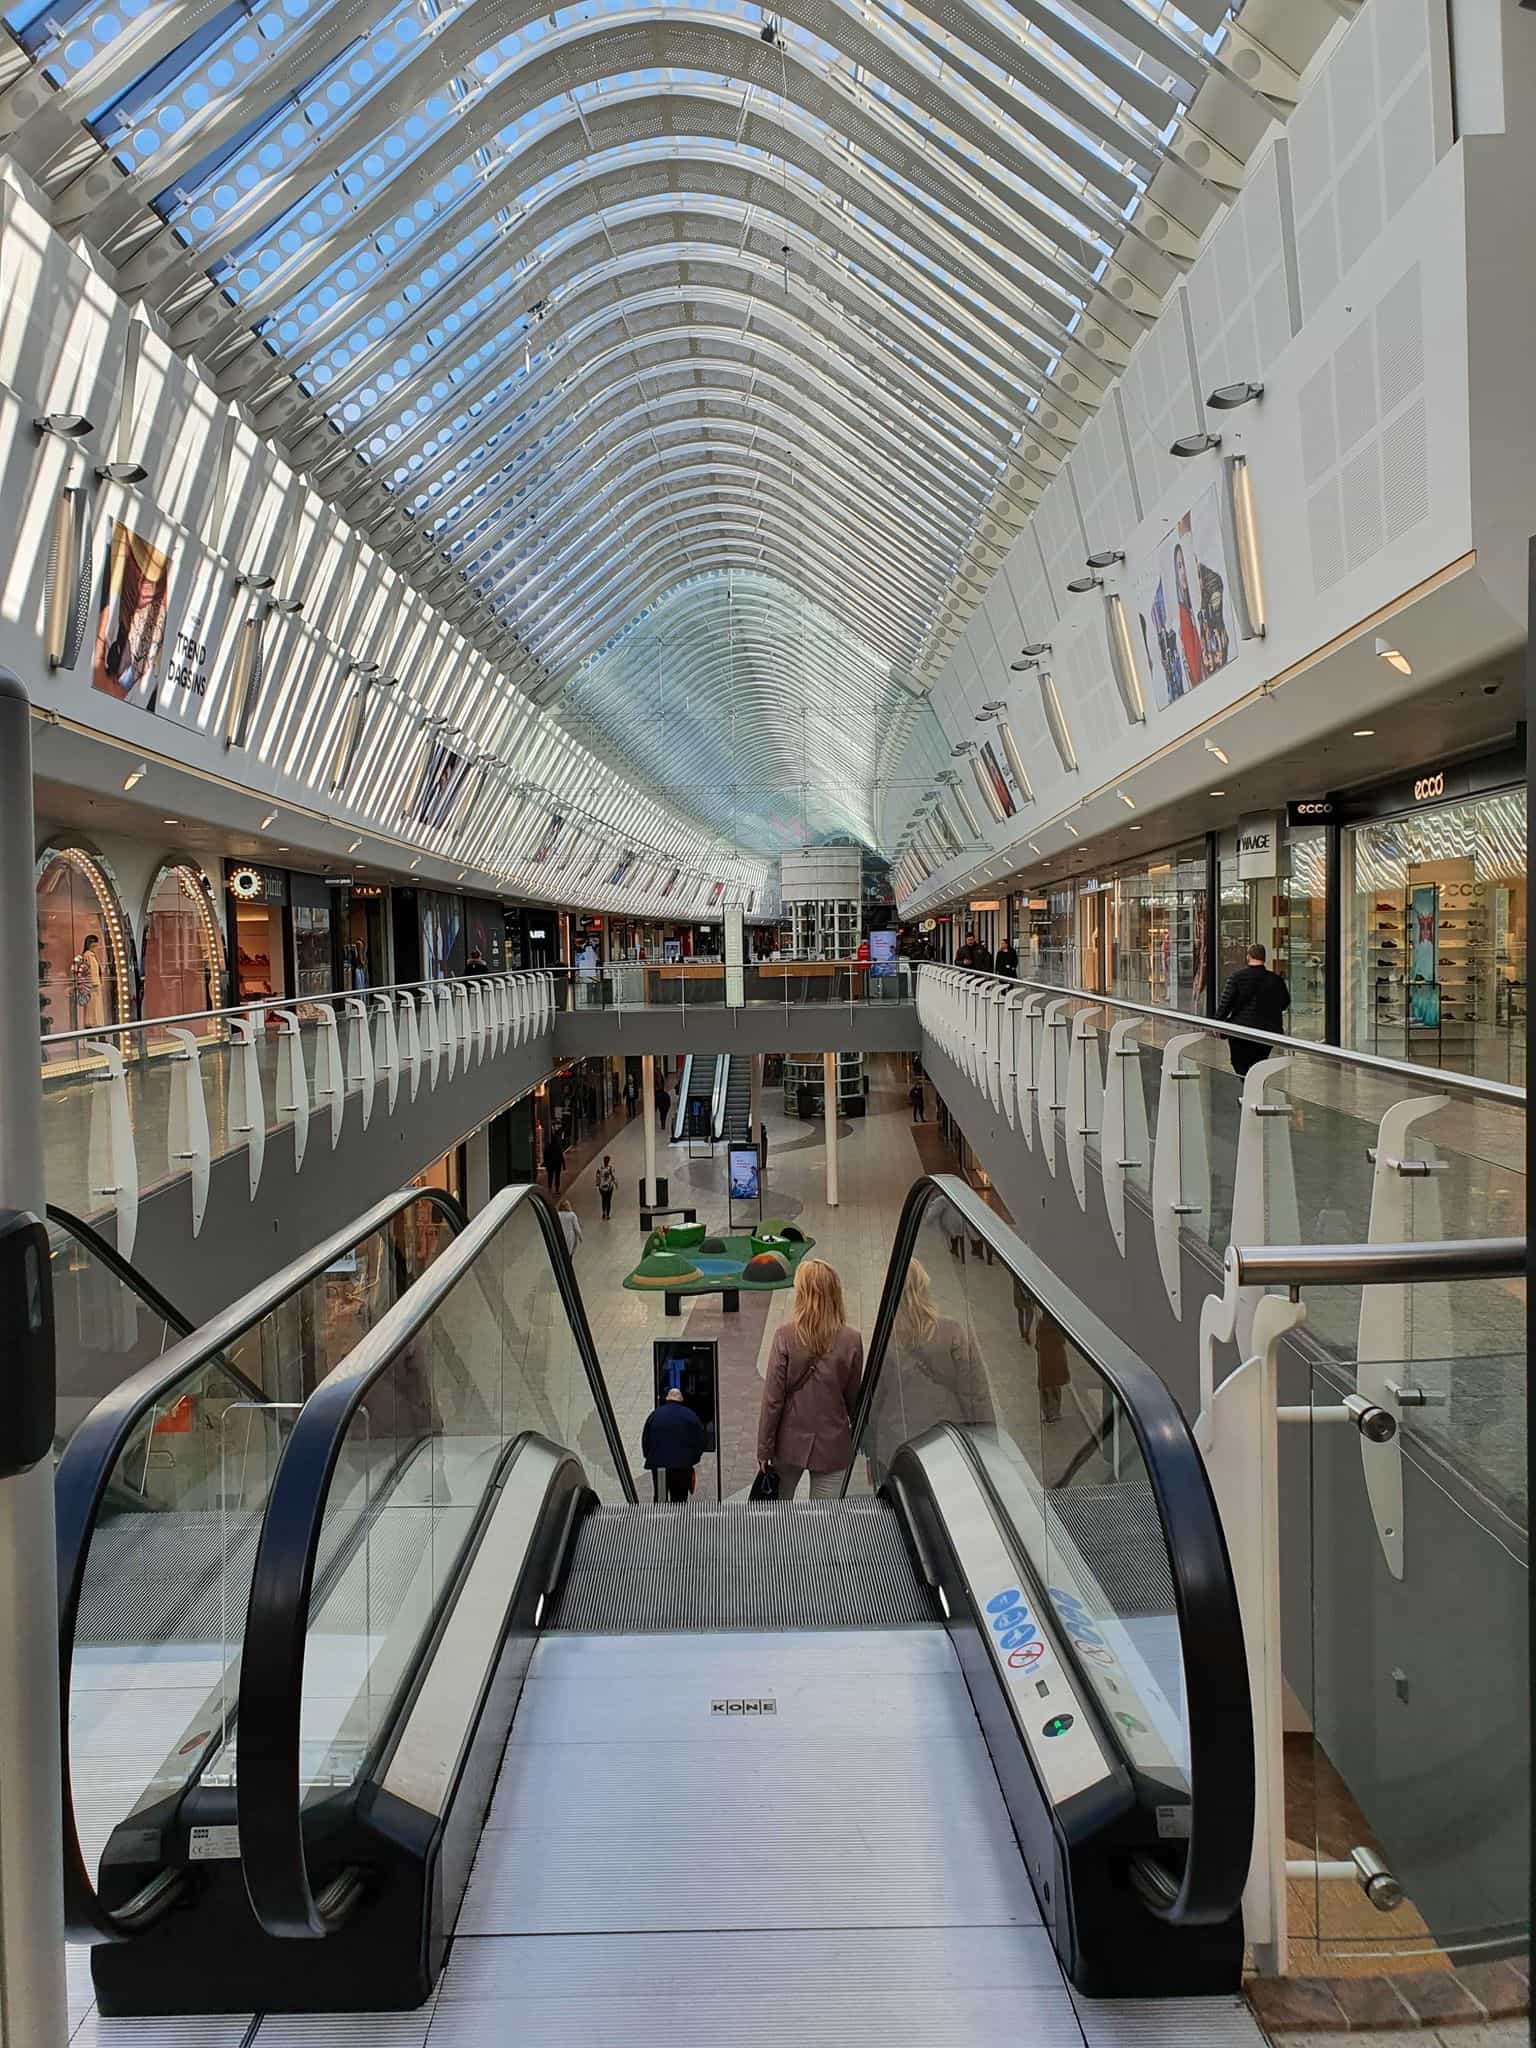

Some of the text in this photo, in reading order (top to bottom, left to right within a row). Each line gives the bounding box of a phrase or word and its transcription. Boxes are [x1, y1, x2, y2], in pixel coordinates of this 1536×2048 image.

[178, 631, 207, 665] TREND
[168, 659, 207, 696] DAGSINS
[1414, 772, 1444, 800] ecco
[1297, 803, 1333, 814] ecco
[355, 887, 382, 895] VILA
[712, 1702, 775, 1713] KONE
